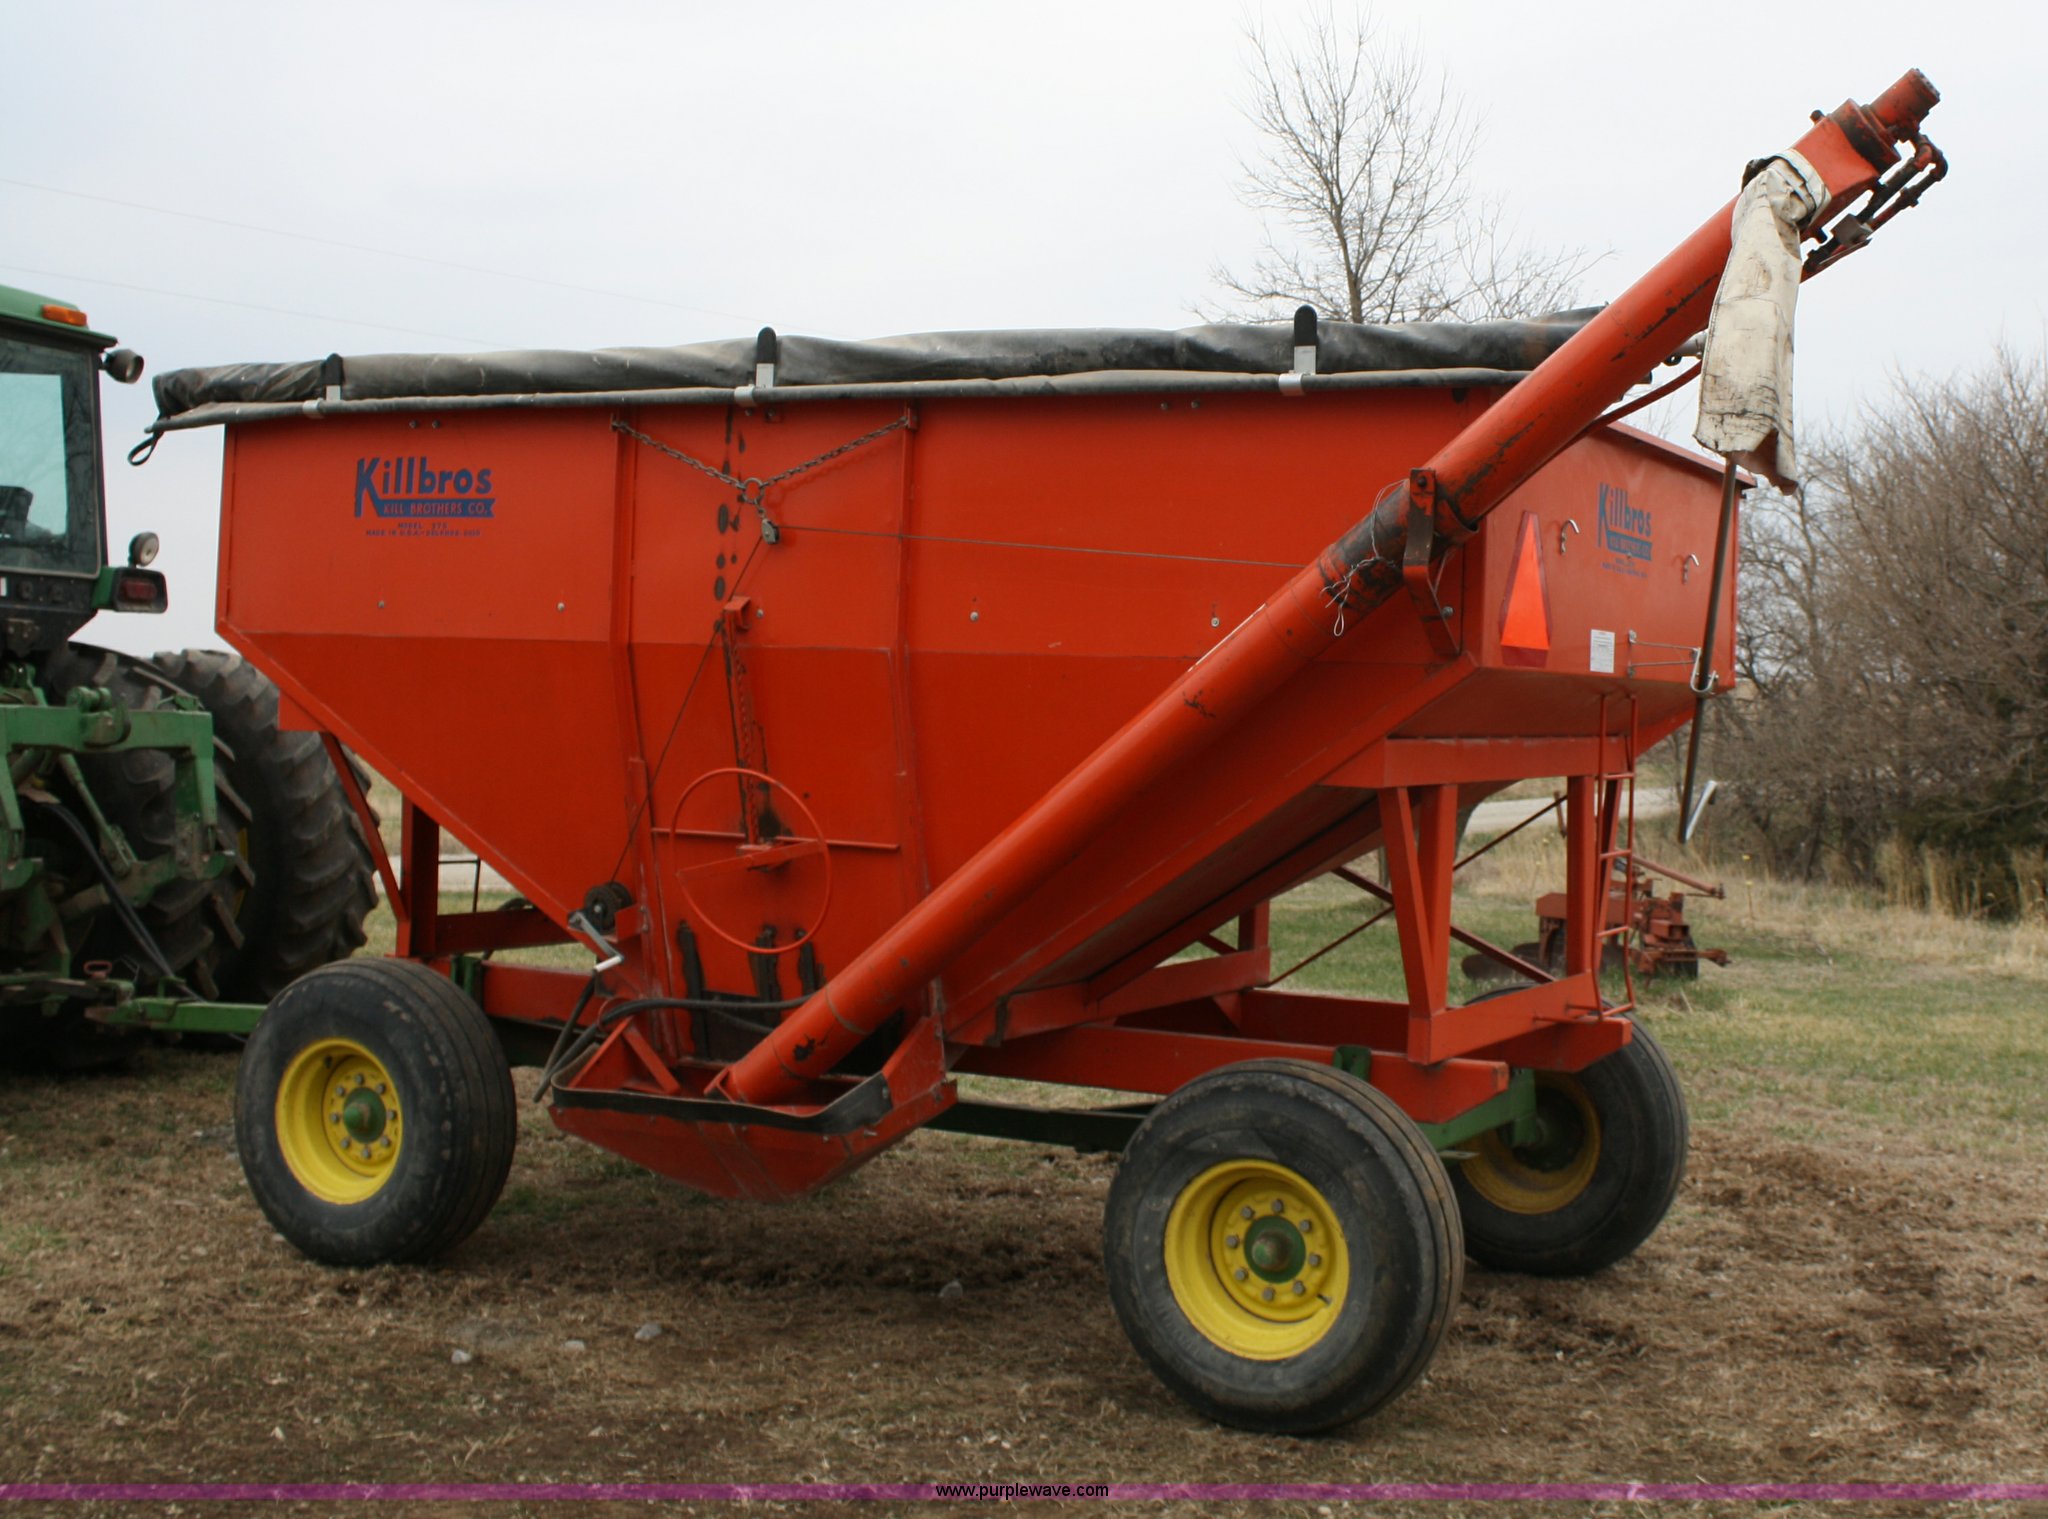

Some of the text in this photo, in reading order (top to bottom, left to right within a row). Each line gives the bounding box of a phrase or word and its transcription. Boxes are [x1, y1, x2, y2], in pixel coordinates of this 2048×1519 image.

[355, 456, 493, 518] Killbros
[383, 501, 488, 515] KILL BROTHERS CO.
[1597, 483, 1652, 549] Killbros
